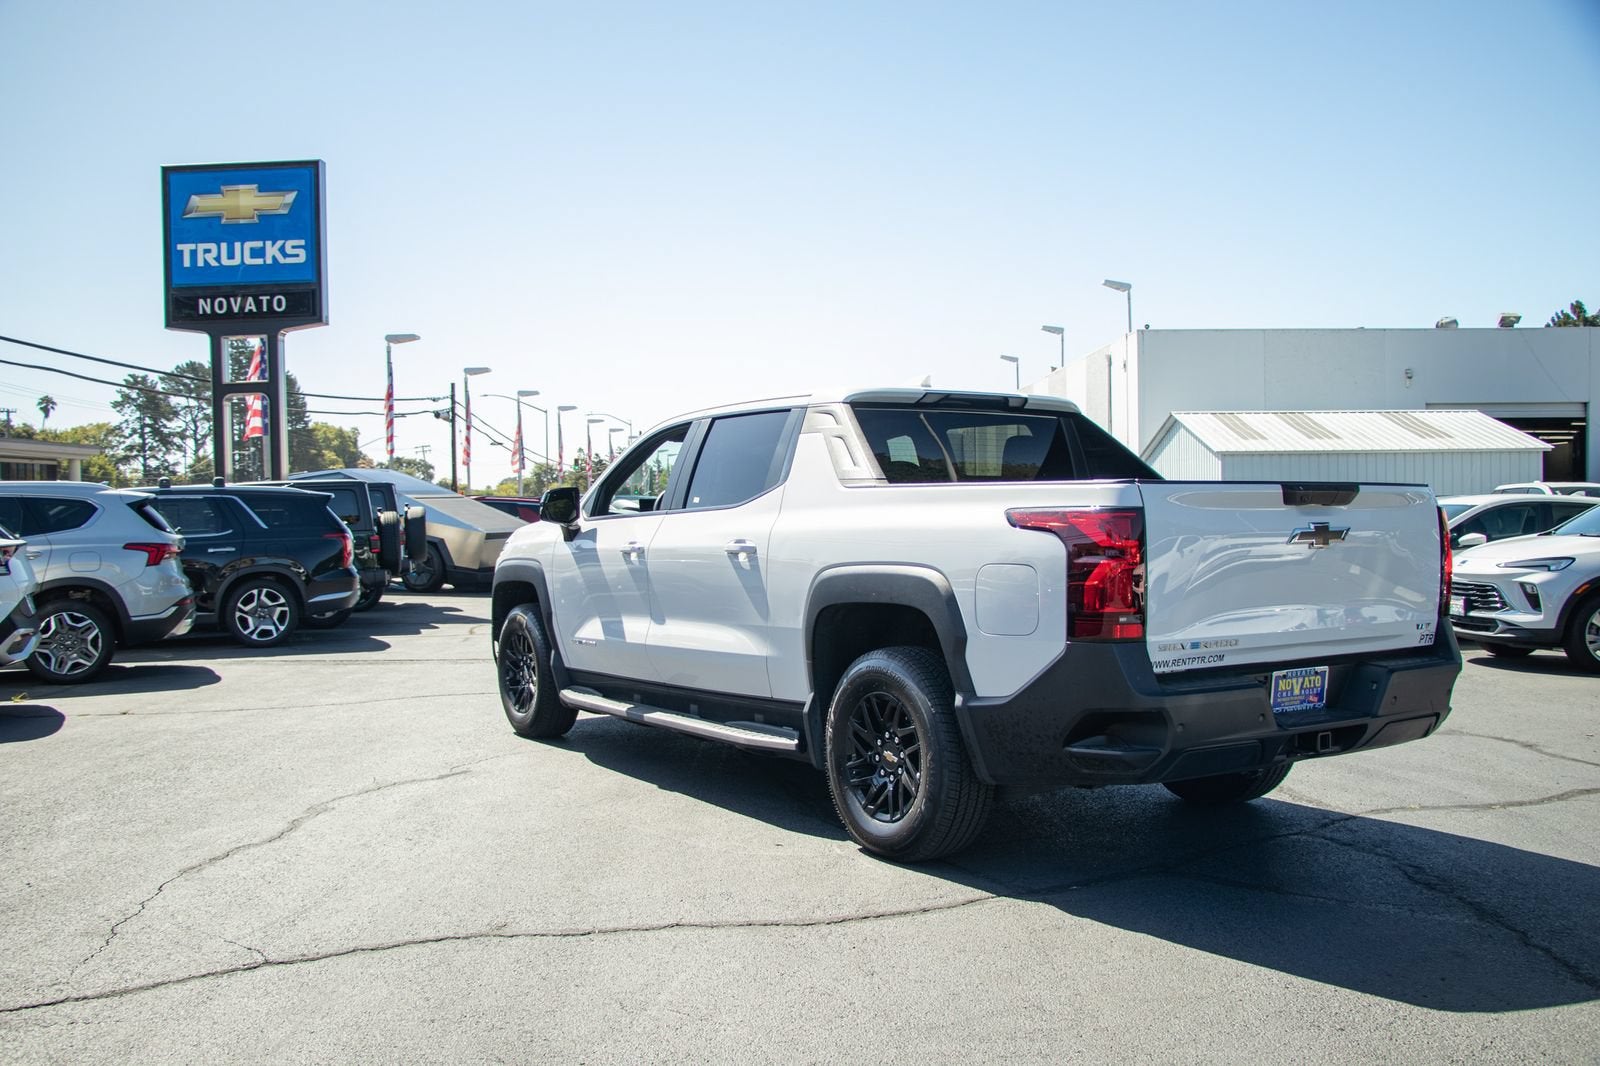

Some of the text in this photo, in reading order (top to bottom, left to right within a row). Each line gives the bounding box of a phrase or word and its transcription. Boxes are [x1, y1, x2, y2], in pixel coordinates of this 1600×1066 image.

[177, 239, 306, 268] TRUCKS
[198, 295, 287, 315] NOVATO
[1419, 633, 1434, 644] PTR
[1152, 654, 1225, 669] WW.RENTPTR.COM
[1279, 676, 1321, 695] NOVATO
